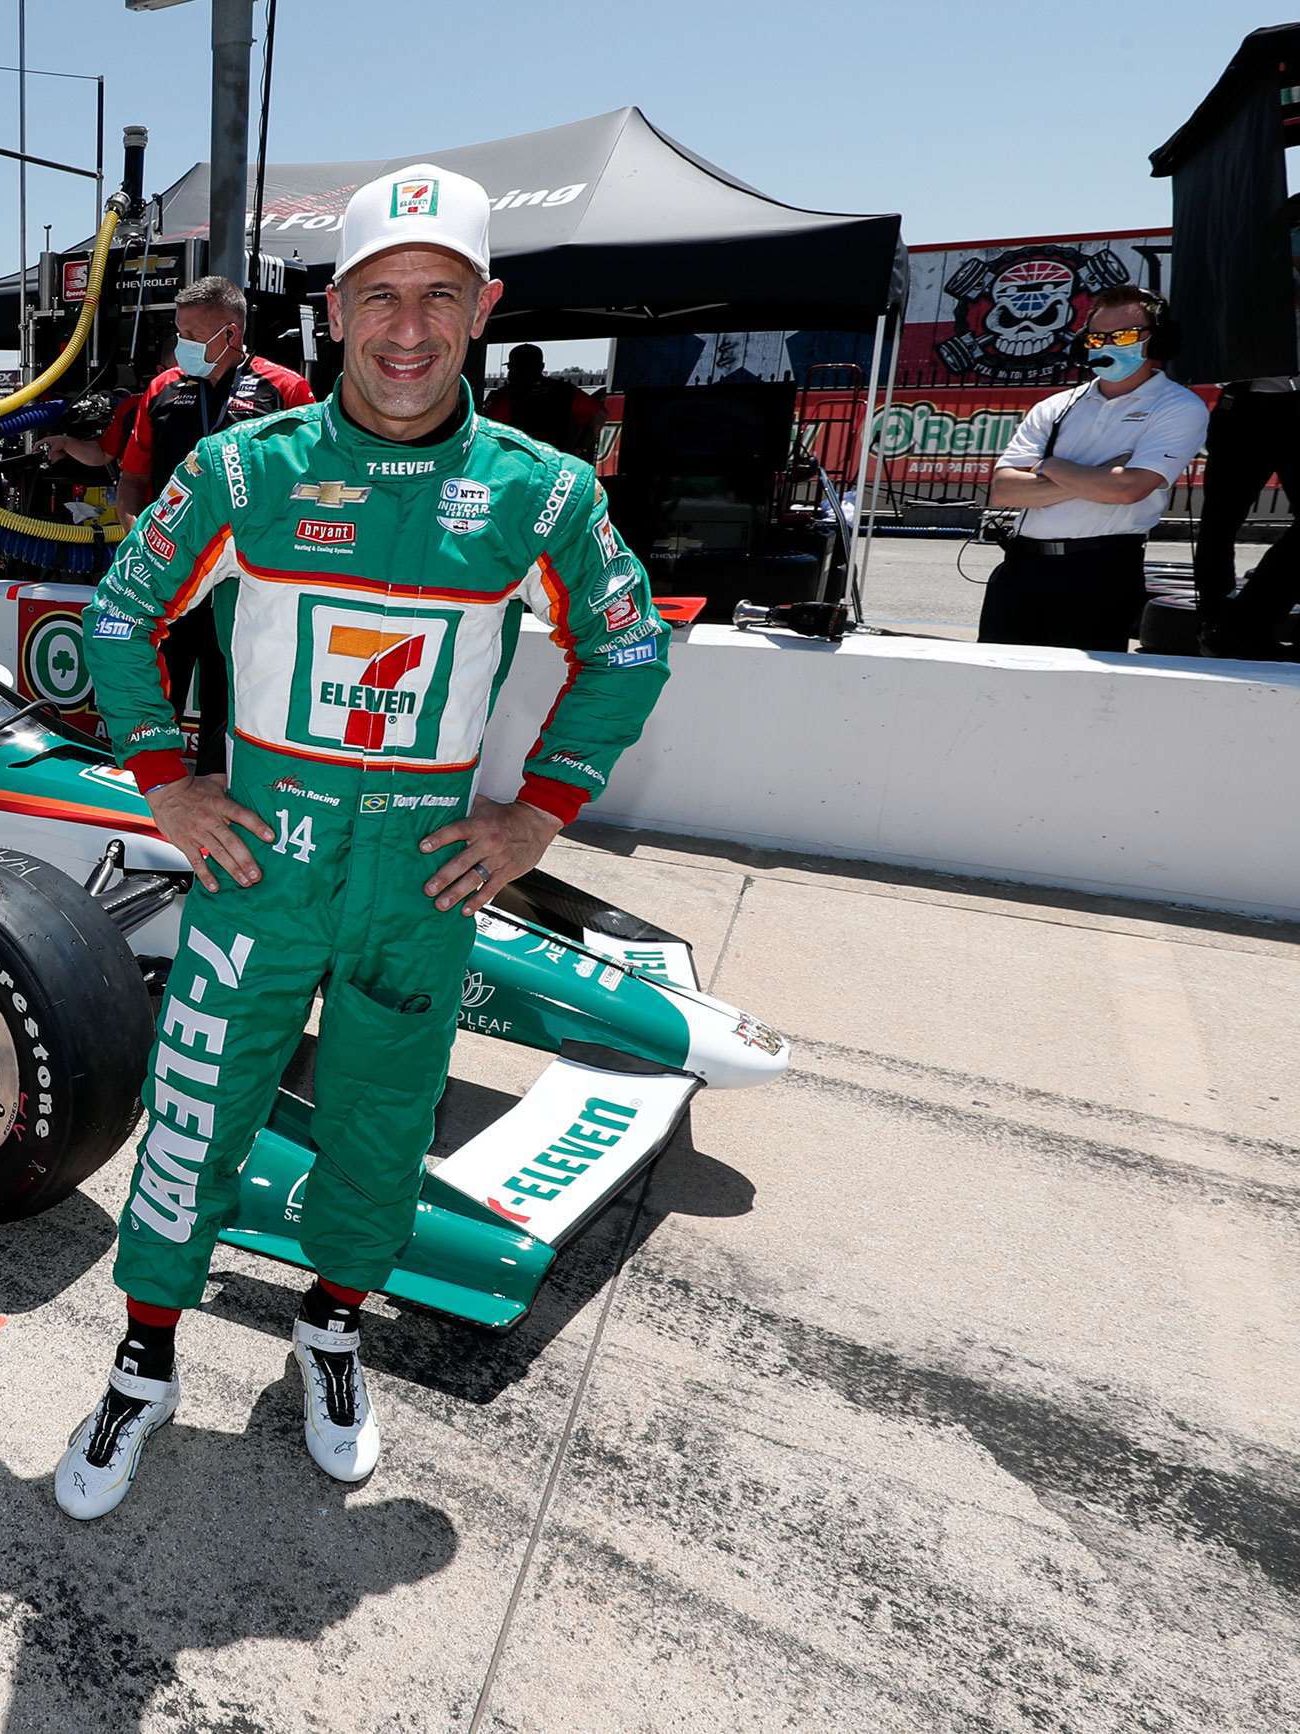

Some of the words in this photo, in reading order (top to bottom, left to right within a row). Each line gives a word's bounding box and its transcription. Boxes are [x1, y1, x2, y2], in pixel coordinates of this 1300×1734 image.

[870, 405, 1018, 456] O'Reill
[908, 463, 943, 473] AUTO
[948, 462, 990, 474] PARTS
[460, 489, 485, 499] NTT
[437, 500, 490, 515] INDYCAR
[304, 523, 349, 539] bryant
[100, 617, 130, 636] ism
[561, 757, 584, 771] Foyt
[276, 780, 287, 793] AJ
[286, 784, 306, 799] Foyt
[306, 789, 341, 806] Racing
[392, 793, 420, 810] Tony
[271, 808, 317, 864] 14
